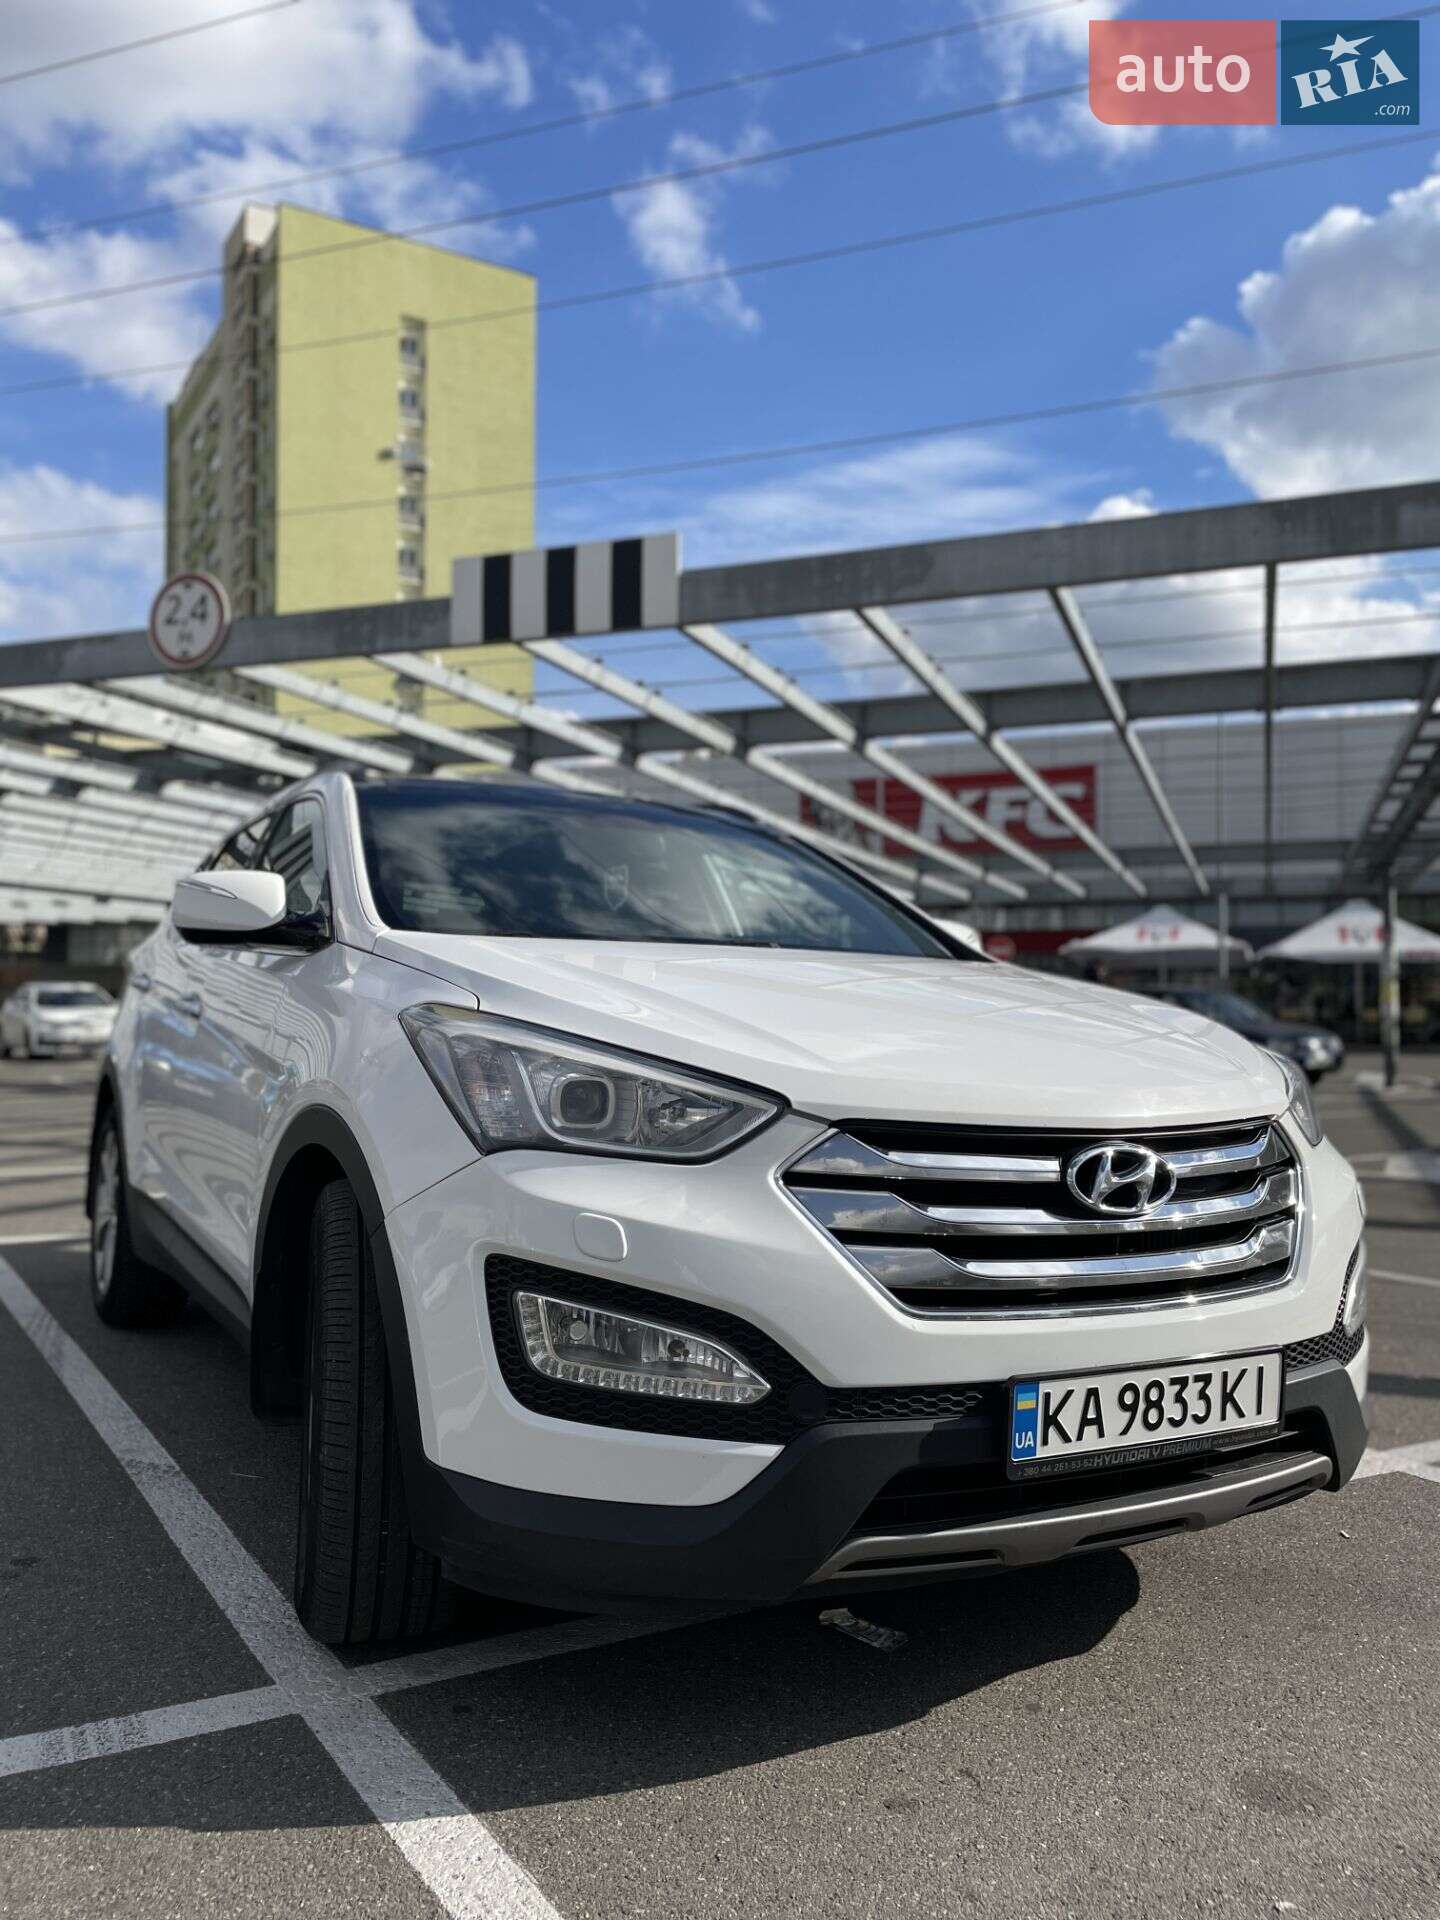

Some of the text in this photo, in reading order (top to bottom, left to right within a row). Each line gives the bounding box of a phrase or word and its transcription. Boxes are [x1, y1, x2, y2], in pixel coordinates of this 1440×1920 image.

[919, 782, 1086, 846] KFC
[1042, 1387, 1105, 1447] KA
[1118, 1372, 1213, 1435] 9833
[1015, 1431, 1034, 1449] UA
[1094, 1447, 1150, 1467] HYUNDAI
[1162, 1438, 1212, 1456] PREMIUM
